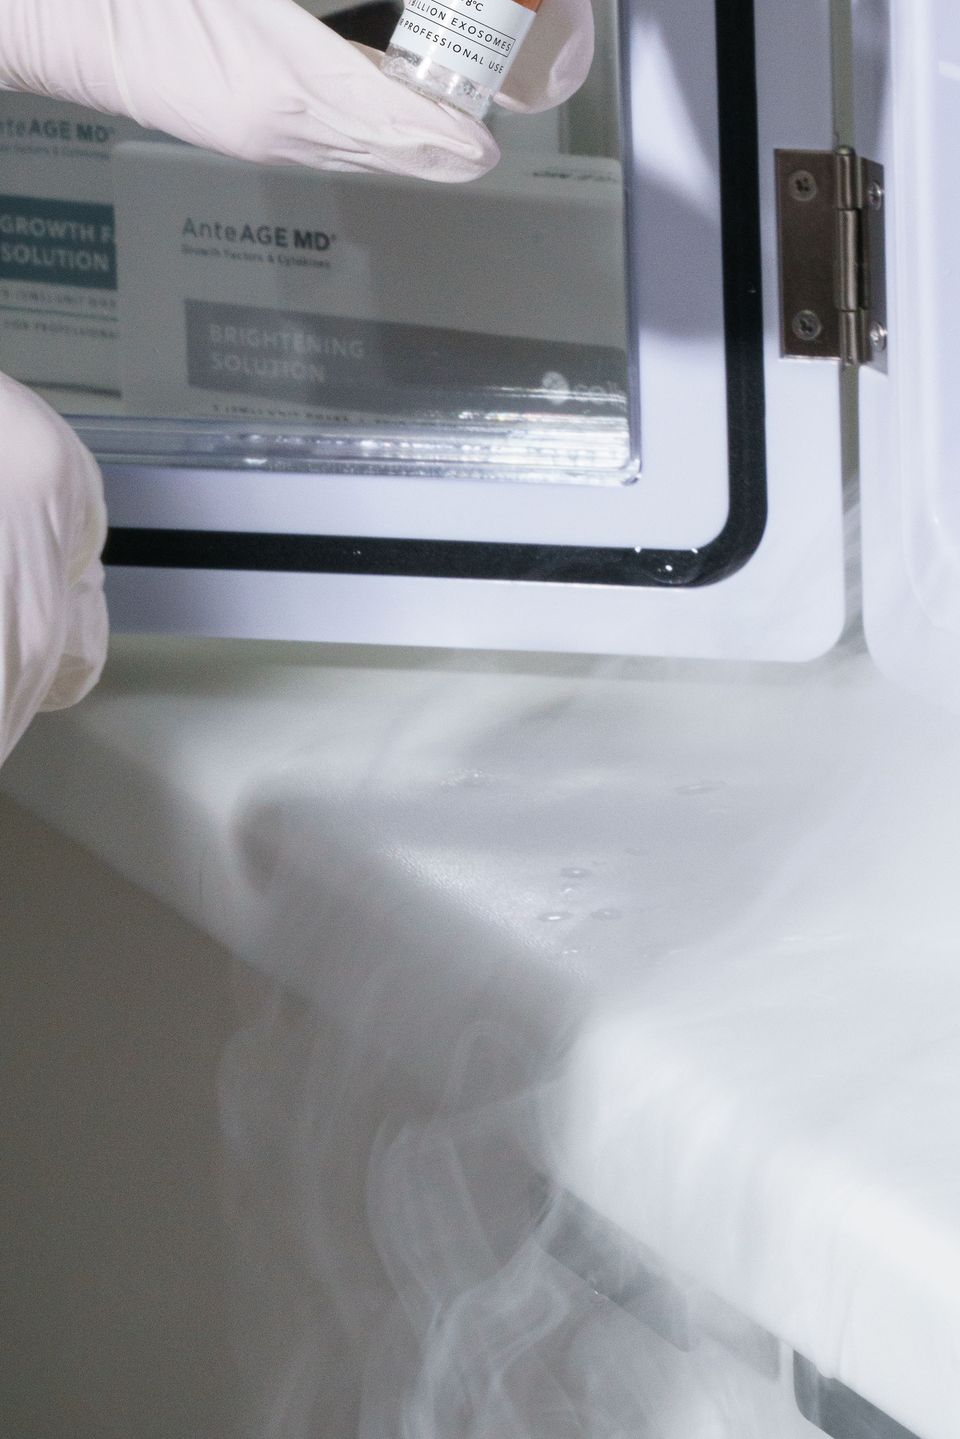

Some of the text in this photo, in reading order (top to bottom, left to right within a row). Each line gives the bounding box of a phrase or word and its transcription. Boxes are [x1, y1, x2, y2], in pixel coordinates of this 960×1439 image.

[404, 20, 505, 74] PROFESSIONAL USE
[450, 17, 512, 52] EXOSOMES
[0, 214, 96, 242] GROWTH
[181, 216, 289, 249] AnteAGE
[0, 241, 111, 273] SOLUTION
[209, 322, 365, 360] BRIGHTENING
[211, 351, 326, 384] SOLUTION
